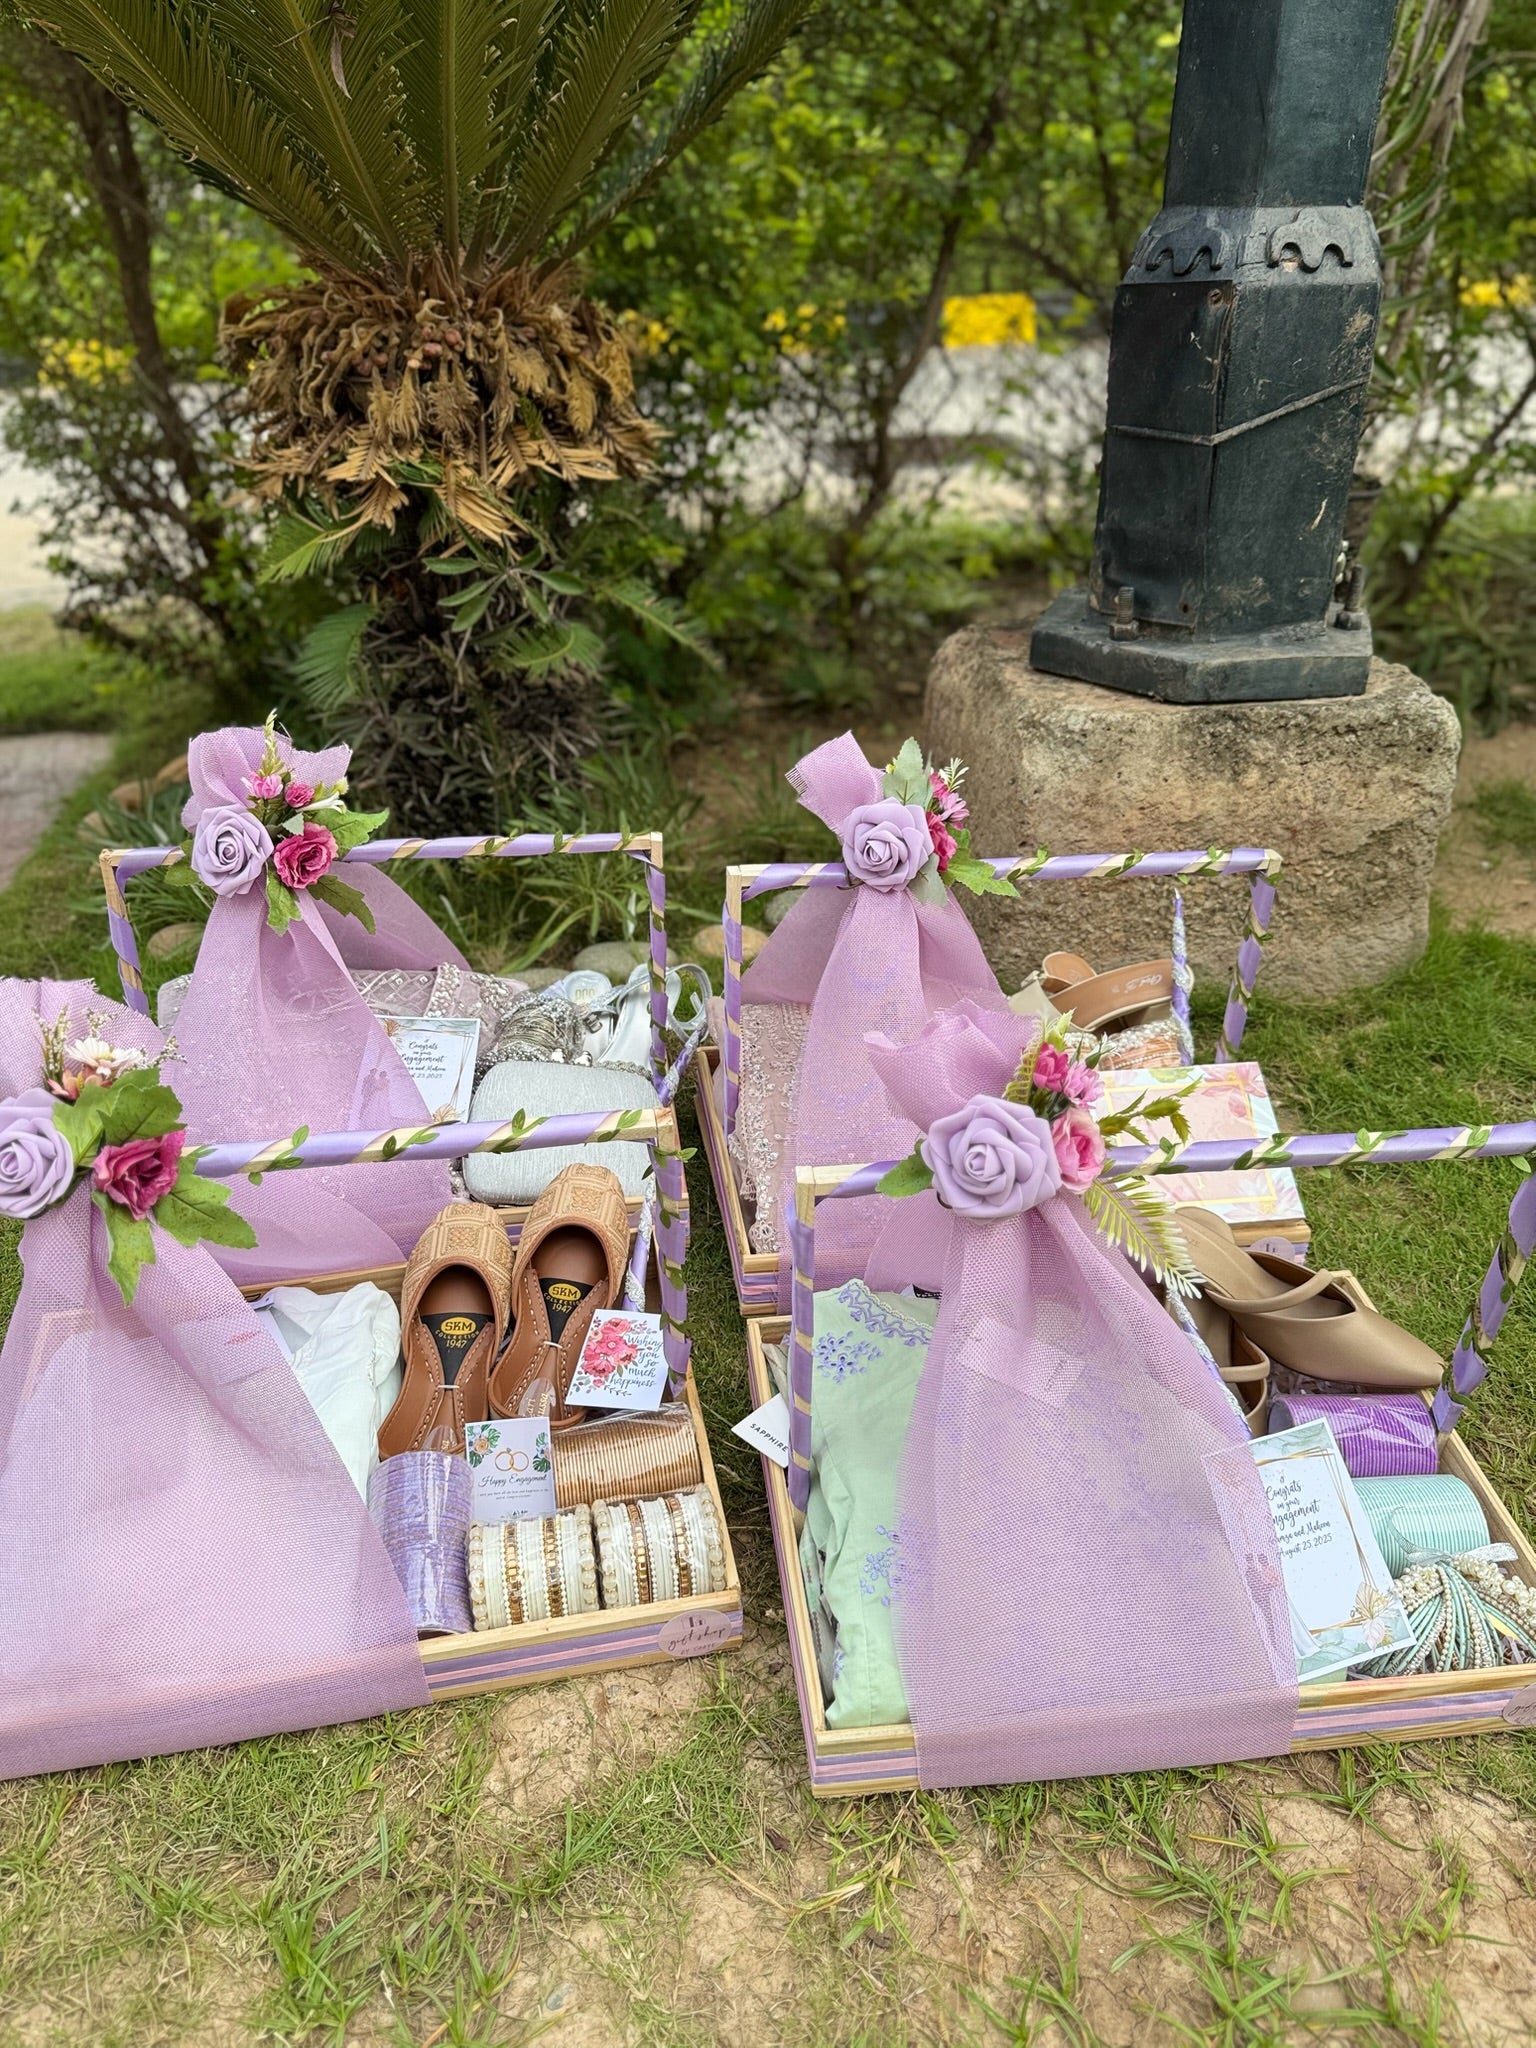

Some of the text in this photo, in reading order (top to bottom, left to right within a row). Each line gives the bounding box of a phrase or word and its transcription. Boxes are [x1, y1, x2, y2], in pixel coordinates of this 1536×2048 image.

[543, 1291, 582, 1306] COLLECTIO
[552, 1286, 579, 1299] SKM
[552, 1303, 573, 1314] 1947
[445, 1320, 473, 1332] SKM
[435, 1329, 480, 1340] COLLECTION
[445, 1340, 467, 1349] 1947
[627, 1334, 663, 1352] Wishing
[638, 1351, 659, 1364] you
[644, 1360, 660, 1368] so
[628, 1367, 657, 1377] much
[750, 1423, 789, 1453] SAPPHIRE
[478, 1472, 547, 1488] Happy Engagement
[1265, 1480, 1302, 1501] Congrats
[1273, 1499, 1321, 1531] ngagement
